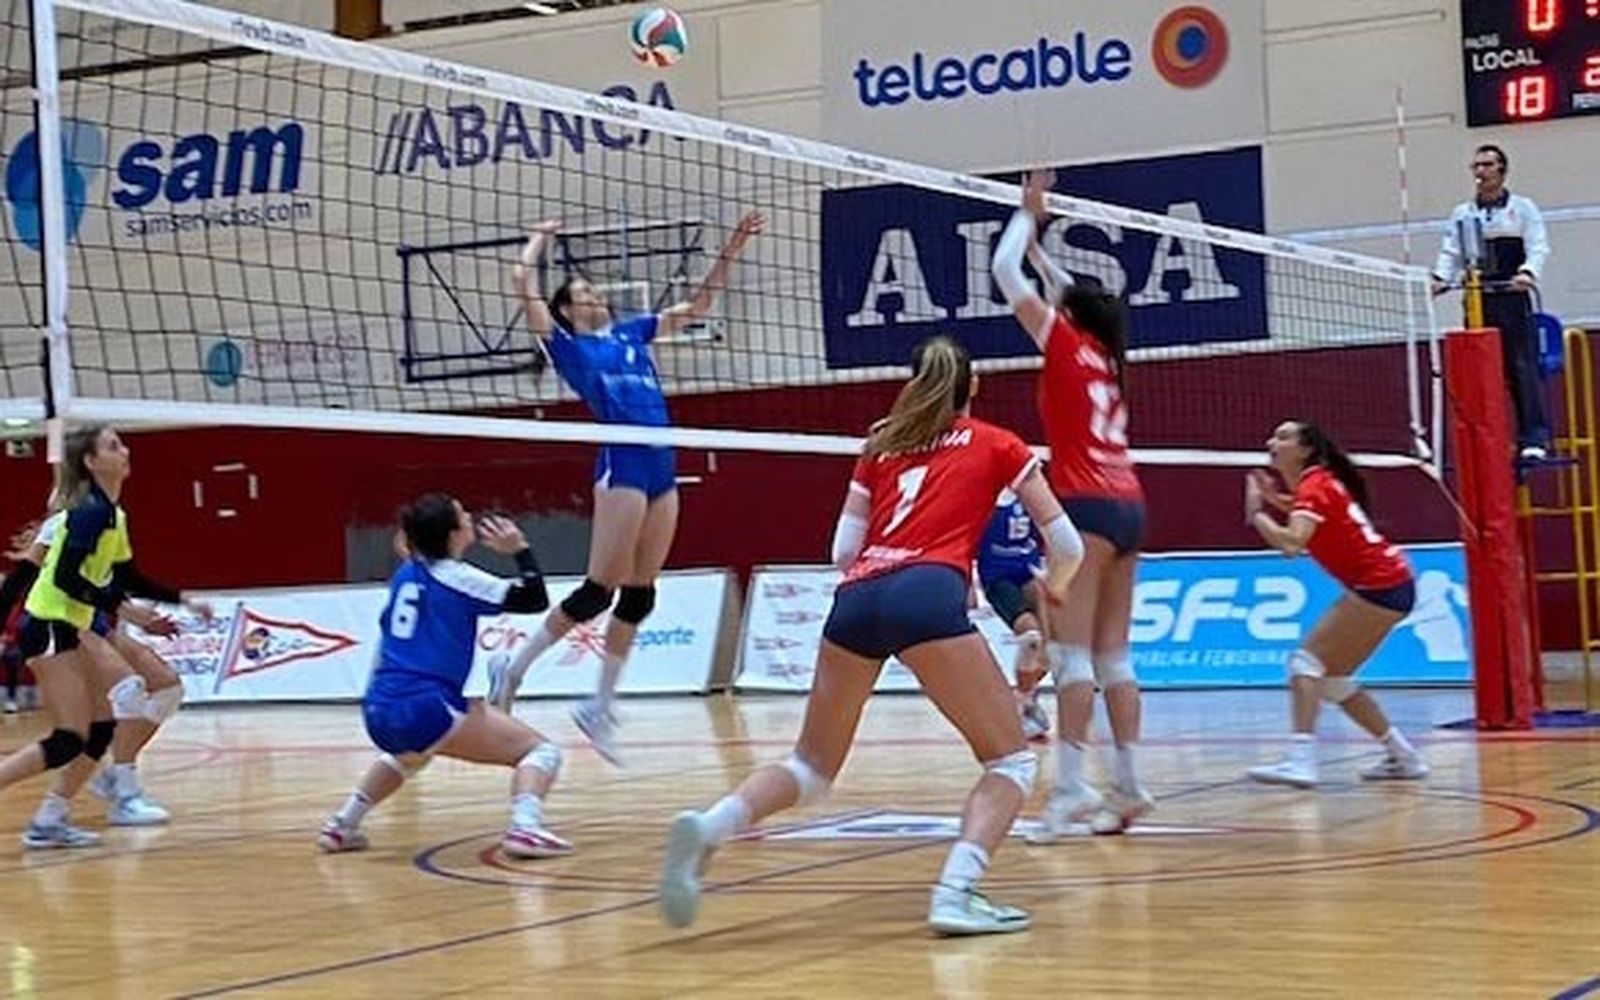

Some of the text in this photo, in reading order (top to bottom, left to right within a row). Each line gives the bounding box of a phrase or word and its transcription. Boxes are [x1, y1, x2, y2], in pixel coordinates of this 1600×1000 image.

[853, 31, 1132, 107] telecable
[1472, 48, 1542, 71] LOCAL
[1506, 77, 1546, 116] 18
[112, 122, 304, 210] sam
[125, 201, 313, 238] samservicios.com
[390, 581, 420, 639] 6
